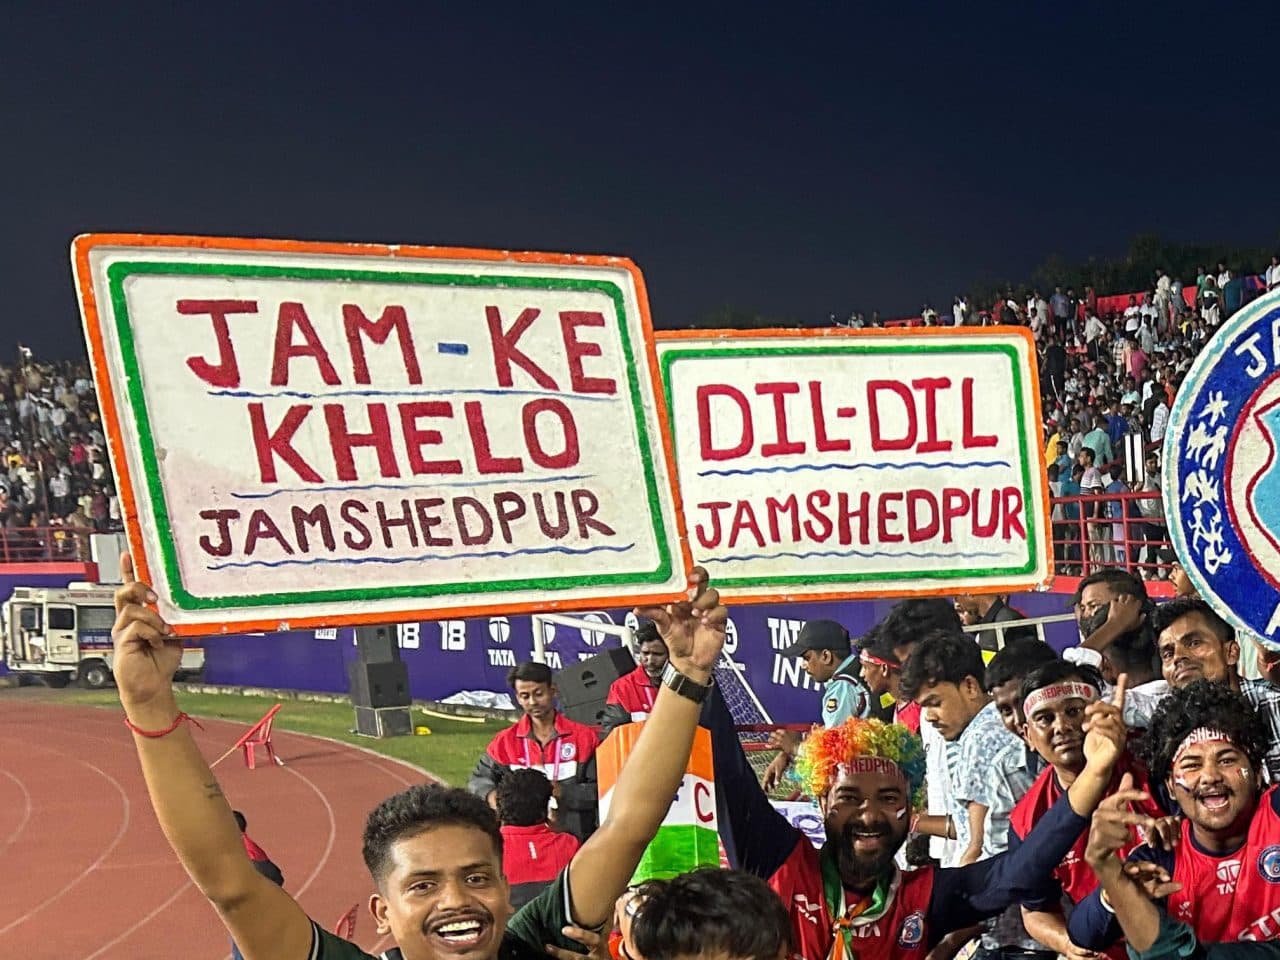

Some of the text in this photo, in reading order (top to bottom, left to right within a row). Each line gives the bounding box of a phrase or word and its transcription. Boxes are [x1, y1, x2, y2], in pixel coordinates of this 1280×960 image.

[247, 398, 580, 484] KHELO
[696, 377, 999, 461] DIL-DIL
[198, 488, 616, 557] JAMSHEDPUR
[695, 486, 1026, 550] JAMSHEDPUR
[438, 620, 466, 650] 18
[488, 649, 516, 667] TATA
[767, 617, 807, 650] TAT
